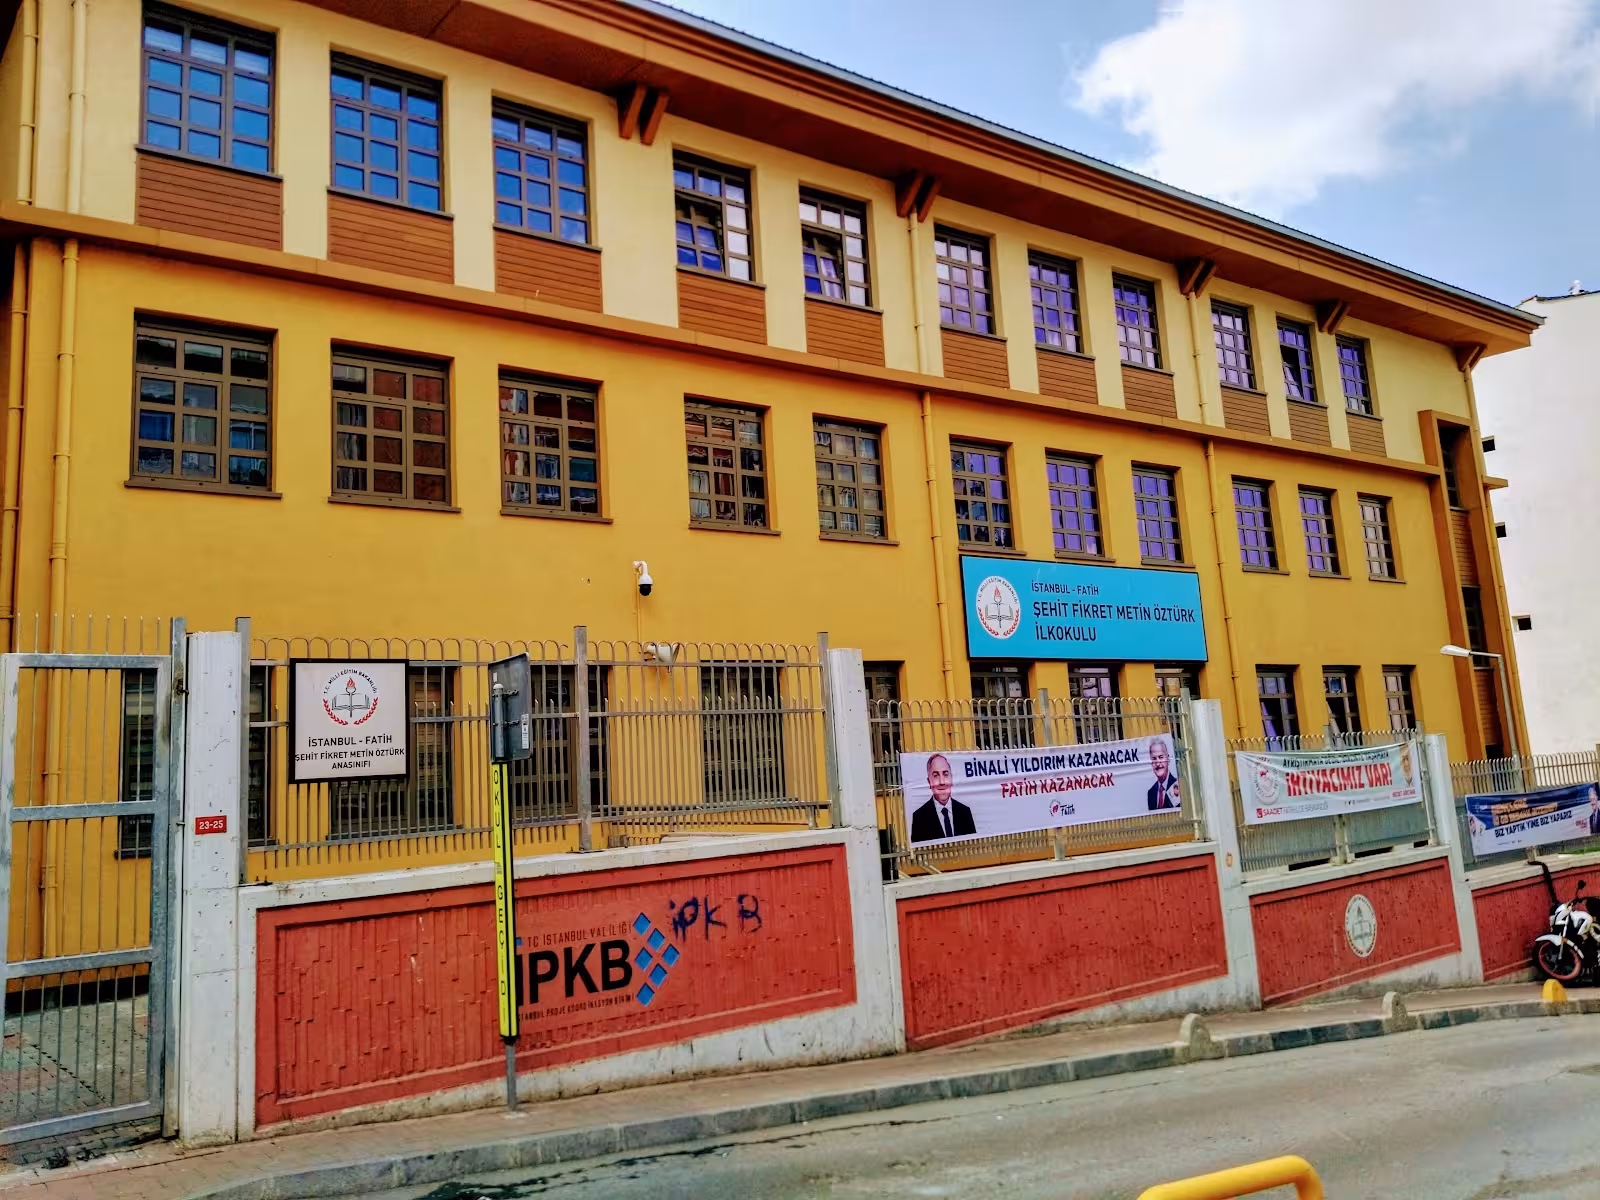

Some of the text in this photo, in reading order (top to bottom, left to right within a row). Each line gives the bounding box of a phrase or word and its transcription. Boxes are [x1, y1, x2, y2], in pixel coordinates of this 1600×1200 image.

[1031, 580, 1070, 594] İSTANBUL
[1077, 584, 1099, 596] FATİH
[1033, 599, 1195, 623] ŞEHİT FİKRET METİN ÖZTÜRK
[1035, 621, 1097, 641] İLKOKULU
[308, 737, 357, 747] İSTANBUL
[365, 733, 393, 745] FATİH
[295, 747, 405, 761] ŞEHİT FİKRET METİN ÖZTÜRK
[964, 748, 1140, 778] BİNALİ YILDIRIM KAZANACAK
[331, 760, 371, 770] ANASINIFI
[1001, 772, 1115, 798] FATİH KAZANACAK
[1286, 766, 1365, 796] İHTİYACIMIZ
[1365, 762, 1392, 788] VAR!
[493, 769, 501, 848] OKUL
[199, 820, 224, 830] 23-25
[527, 936, 539, 948] TC
[543, 928, 588, 945] İSTANBUL
